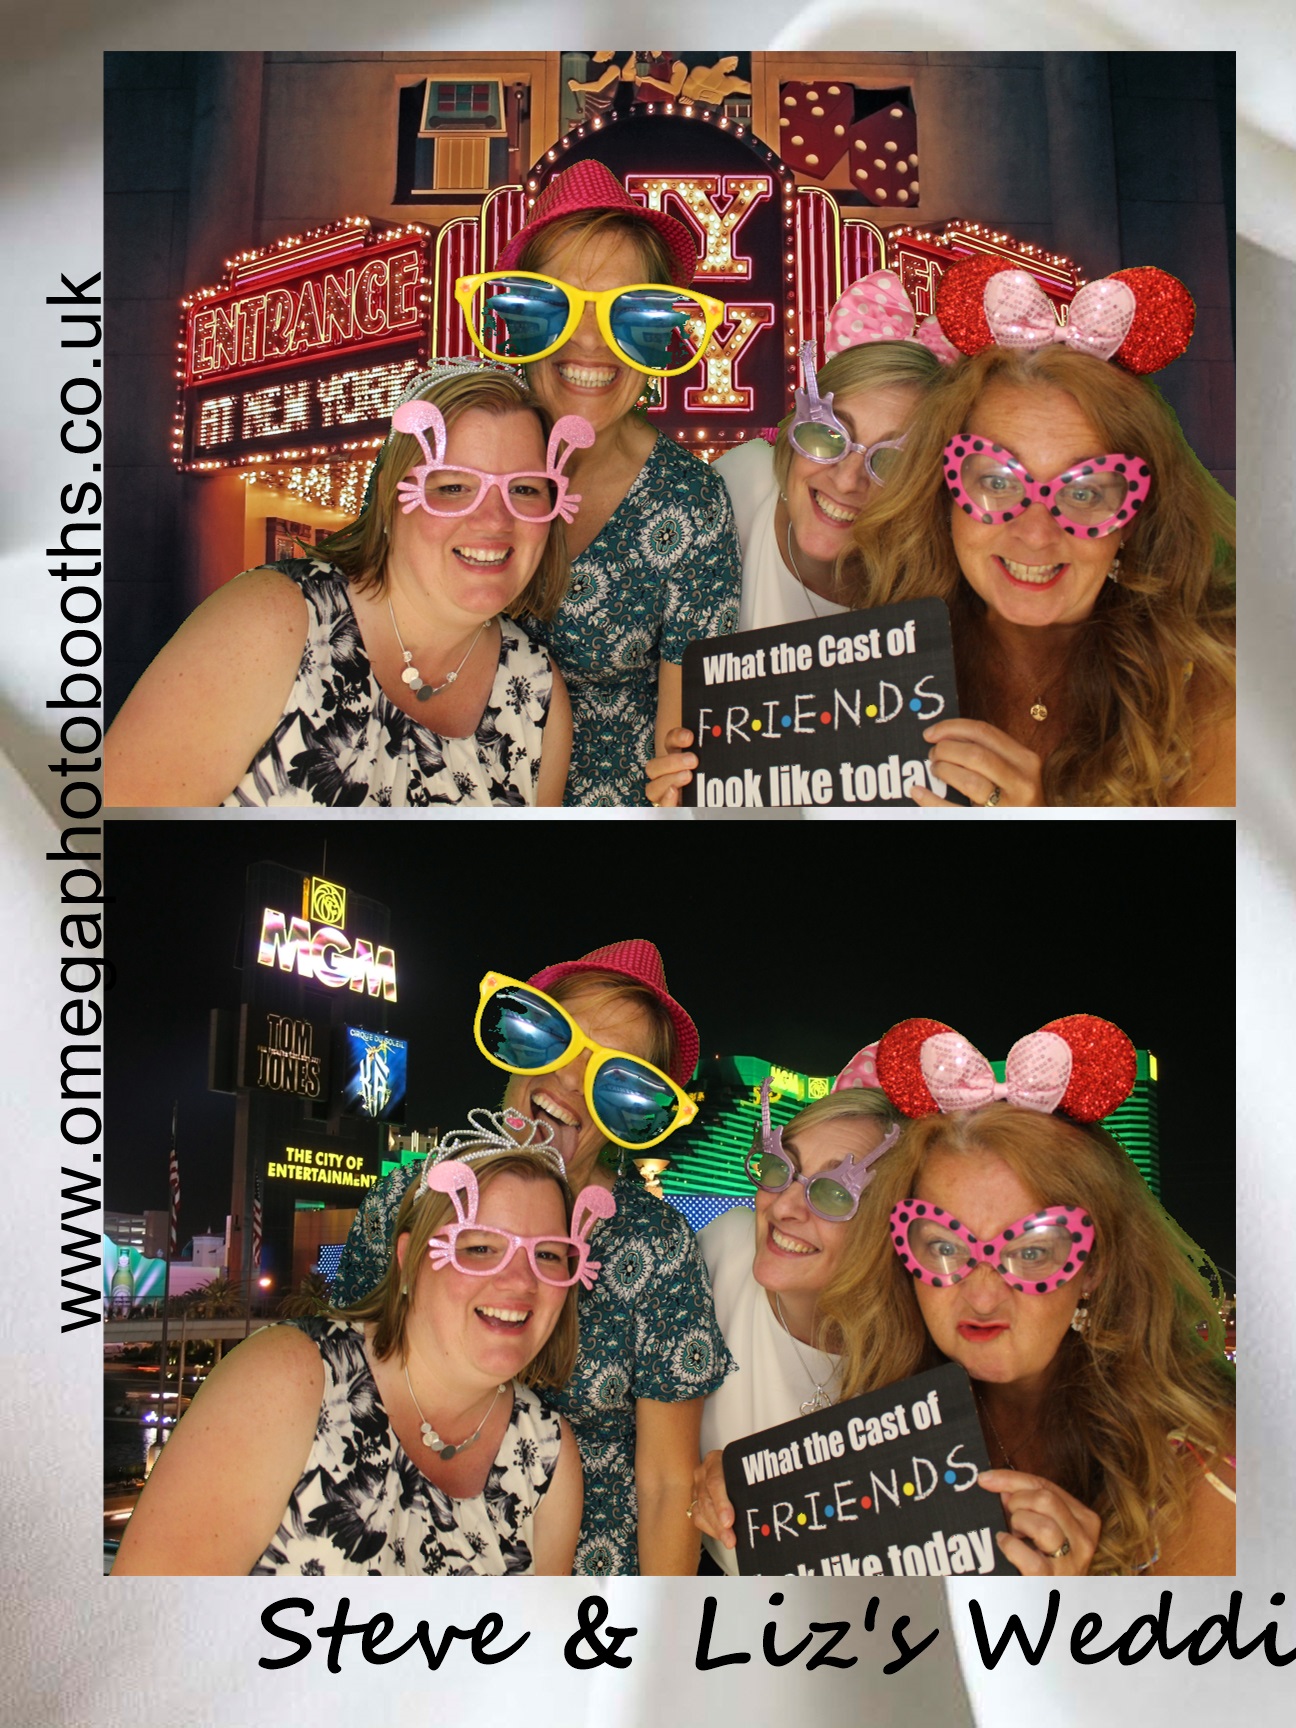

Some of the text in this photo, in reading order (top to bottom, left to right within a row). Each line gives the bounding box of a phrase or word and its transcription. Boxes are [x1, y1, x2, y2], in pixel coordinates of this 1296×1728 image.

[192, 249, 419, 374] ENTRANCE
[703, 619, 916, 686] What the Cast of
[697, 768, 763, 807] look
[769, 764, 834, 807] like
[257, 907, 397, 1003] MGM
[266, 1013, 313, 1056] TOM
[257, 1052, 321, 1098] JONES
[267, 1162, 378, 1189] ENTERTAINMENT
[286, 1147, 364, 1171] THE CITY OF
[742, 1390, 942, 1486] What the Cast of
[887, 1527, 996, 1576] today
